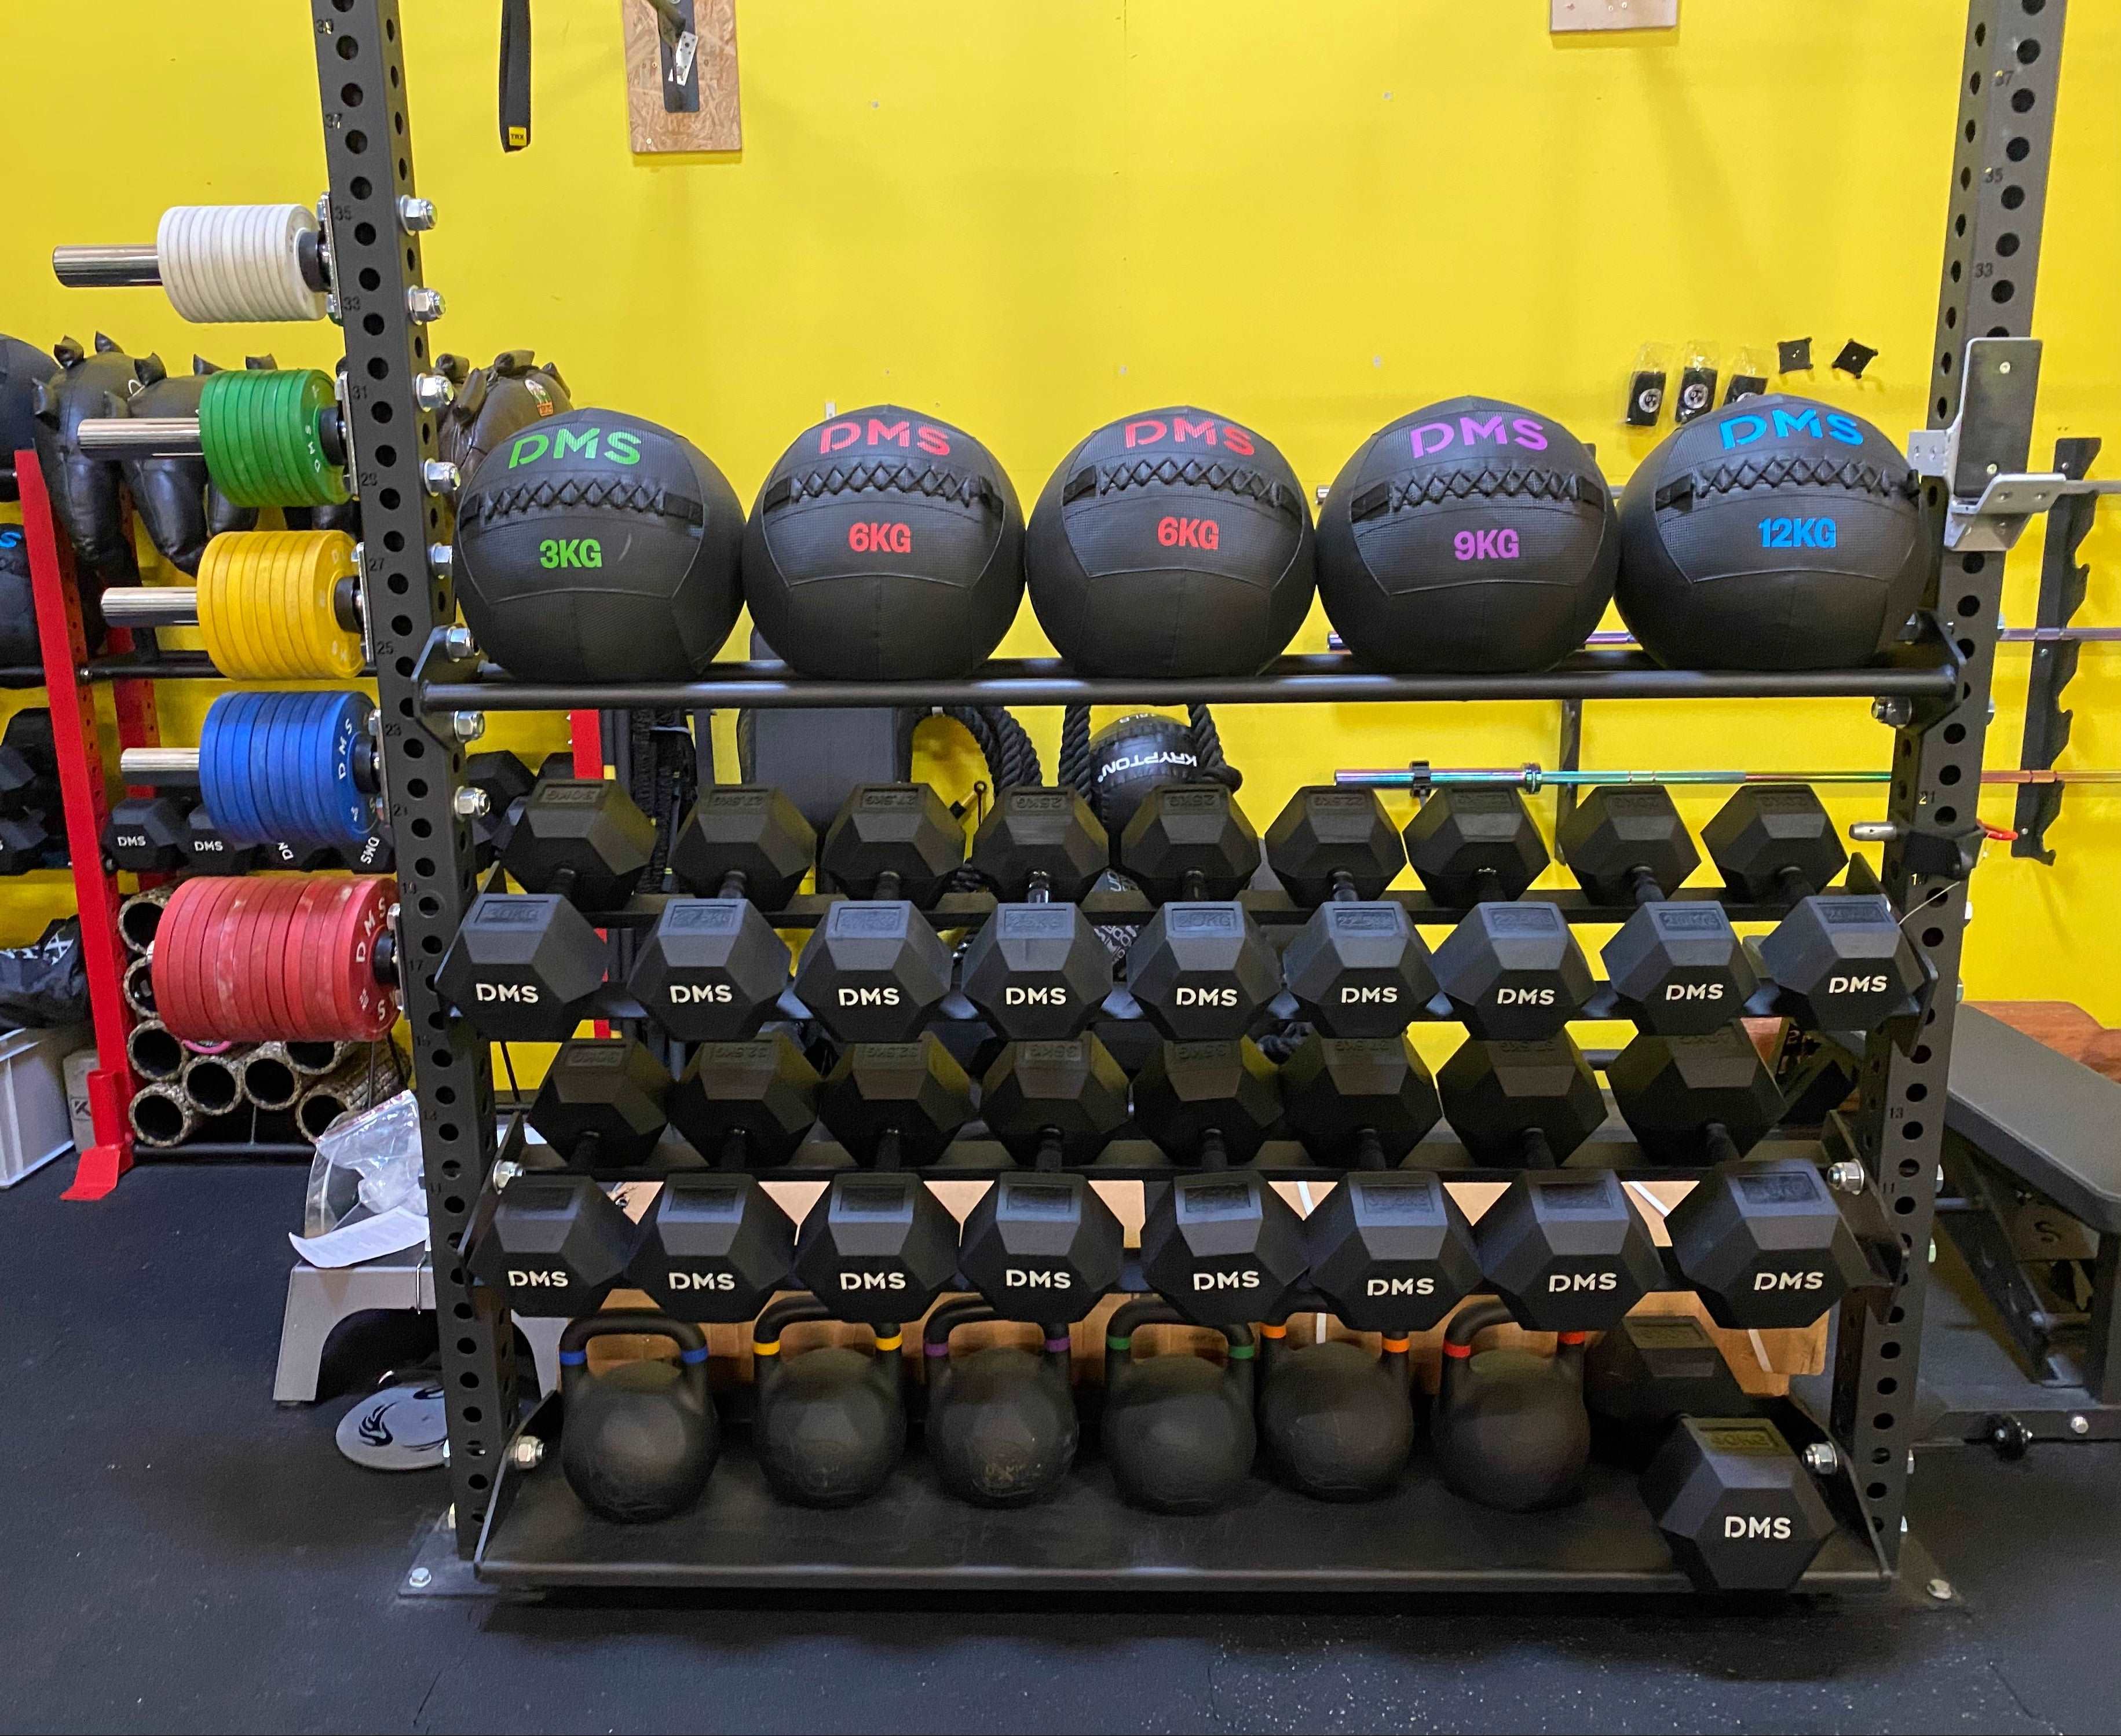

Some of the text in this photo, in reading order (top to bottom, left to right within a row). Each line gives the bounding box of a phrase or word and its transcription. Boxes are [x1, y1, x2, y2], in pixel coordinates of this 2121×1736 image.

[510, 132, 525, 141] TRX
[334, 205, 352, 221] 35
[1974, 262, 1994, 278] 33
[343, 296, 361, 312] 33
[352, 385, 368, 400] 31
[820, 419, 950, 455] DMS
[1125, 417, 1255, 456] DMS
[1410, 416, 1548, 459] DMS
[1719, 408, 1864, 449] DMS
[507, 427, 642, 469] DMS
[360, 472, 378, 487] 29
[848, 522, 912, 554] 6KG
[1157, 516, 1220, 550] 6KG
[1758, 517, 1837, 548] 12KG
[539, 538, 602, 569] 3KG
[1454, 528, 1520, 561] 9KG
[368, 557, 385, 572] 27
[377, 641, 394, 655] 25
[385, 723, 402, 737] 23
[1102, 751, 1198, 778] KRYPTON
[1169, 794, 1215, 806] 25KG
[1918, 791, 1936, 805] 21
[117, 835, 146, 847] DMS
[194, 840, 223, 852] DMS
[360, 836, 380, 865] DMS
[409, 960, 423, 972] 17
[476, 983, 539, 1004] DMS
[669, 984, 733, 1004] DMS
[1665, 983, 1724, 1001] DMS
[1828, 975, 1888, 994] DMS
[838, 987, 900, 1006] DMS
[1005, 986, 1066, 1006] DMS
[1176, 987, 1238, 1007] DMS
[1341, 986, 1398, 1004] DMS
[1497, 988, 1556, 1006] DMS
[1890, 1108, 1904, 1119] 13
[507, 1270, 569, 1288] DMS
[668, 1272, 736, 1291] DMS
[839, 1272, 906, 1291] DMS
[1005, 1269, 1072, 1289] DMS
[1193, 1270, 1260, 1291] DMS
[1366, 1277, 1435, 1297] DMS
[1548, 1272, 1618, 1292] DMS
[1753, 1271, 1824, 1291] DMS
[1724, 1515, 1792, 1540] DMS
